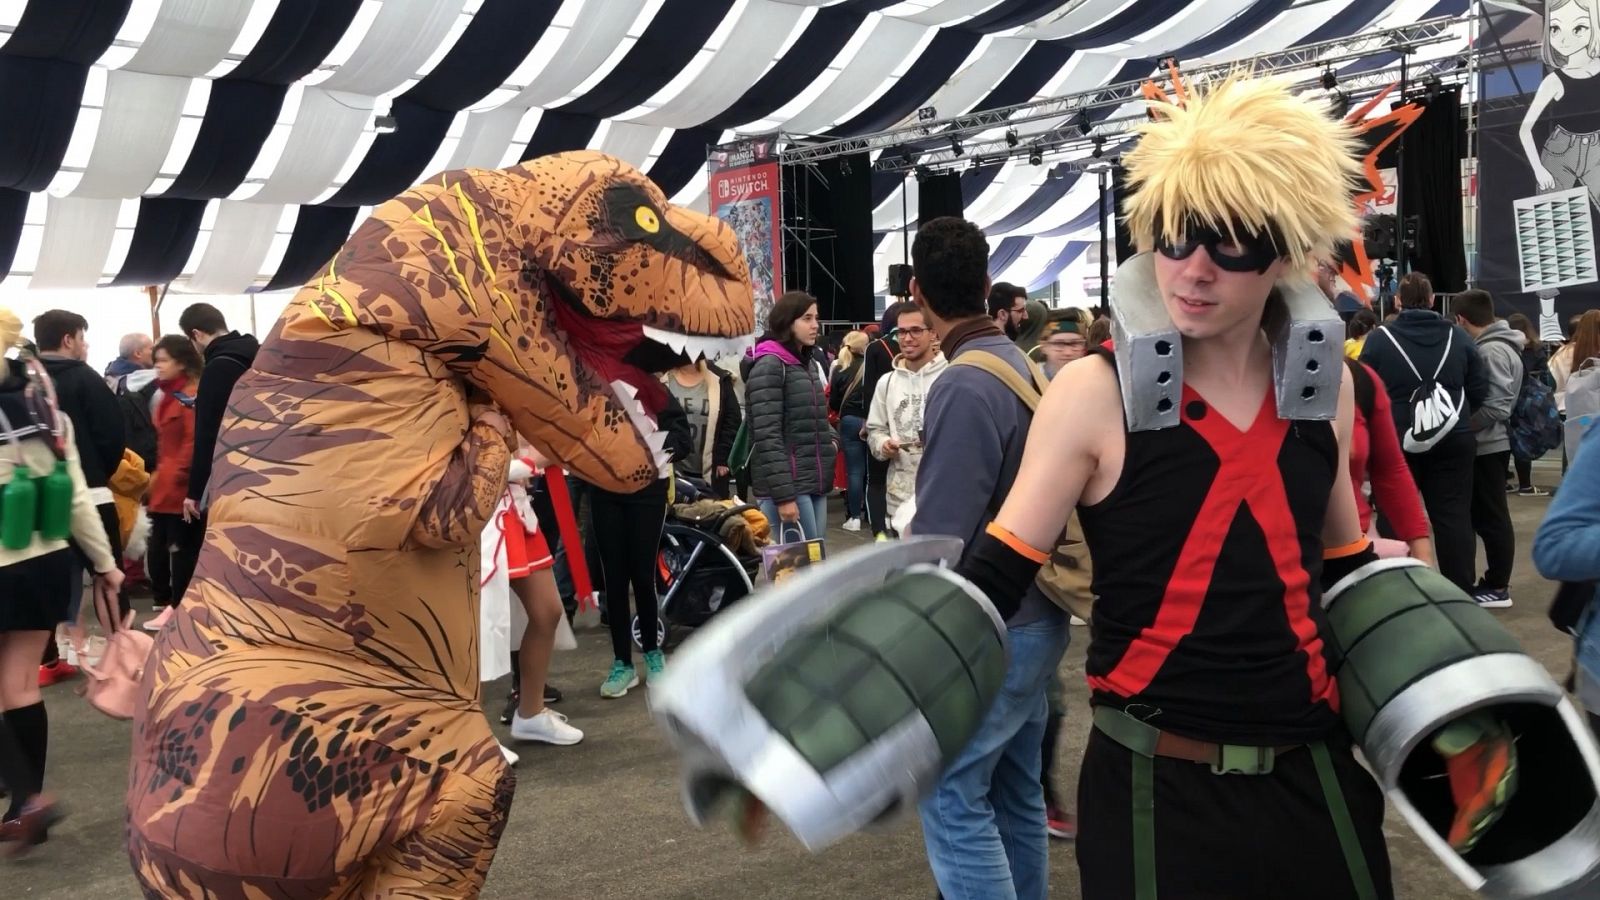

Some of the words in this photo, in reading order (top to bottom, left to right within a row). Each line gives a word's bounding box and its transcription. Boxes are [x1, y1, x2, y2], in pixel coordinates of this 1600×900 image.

[729, 150, 755, 163] MANGA
[730, 172, 767, 184] NINTENDO
[731, 179, 768, 196] SWITCH
[1413, 382, 1457, 435] NIK
